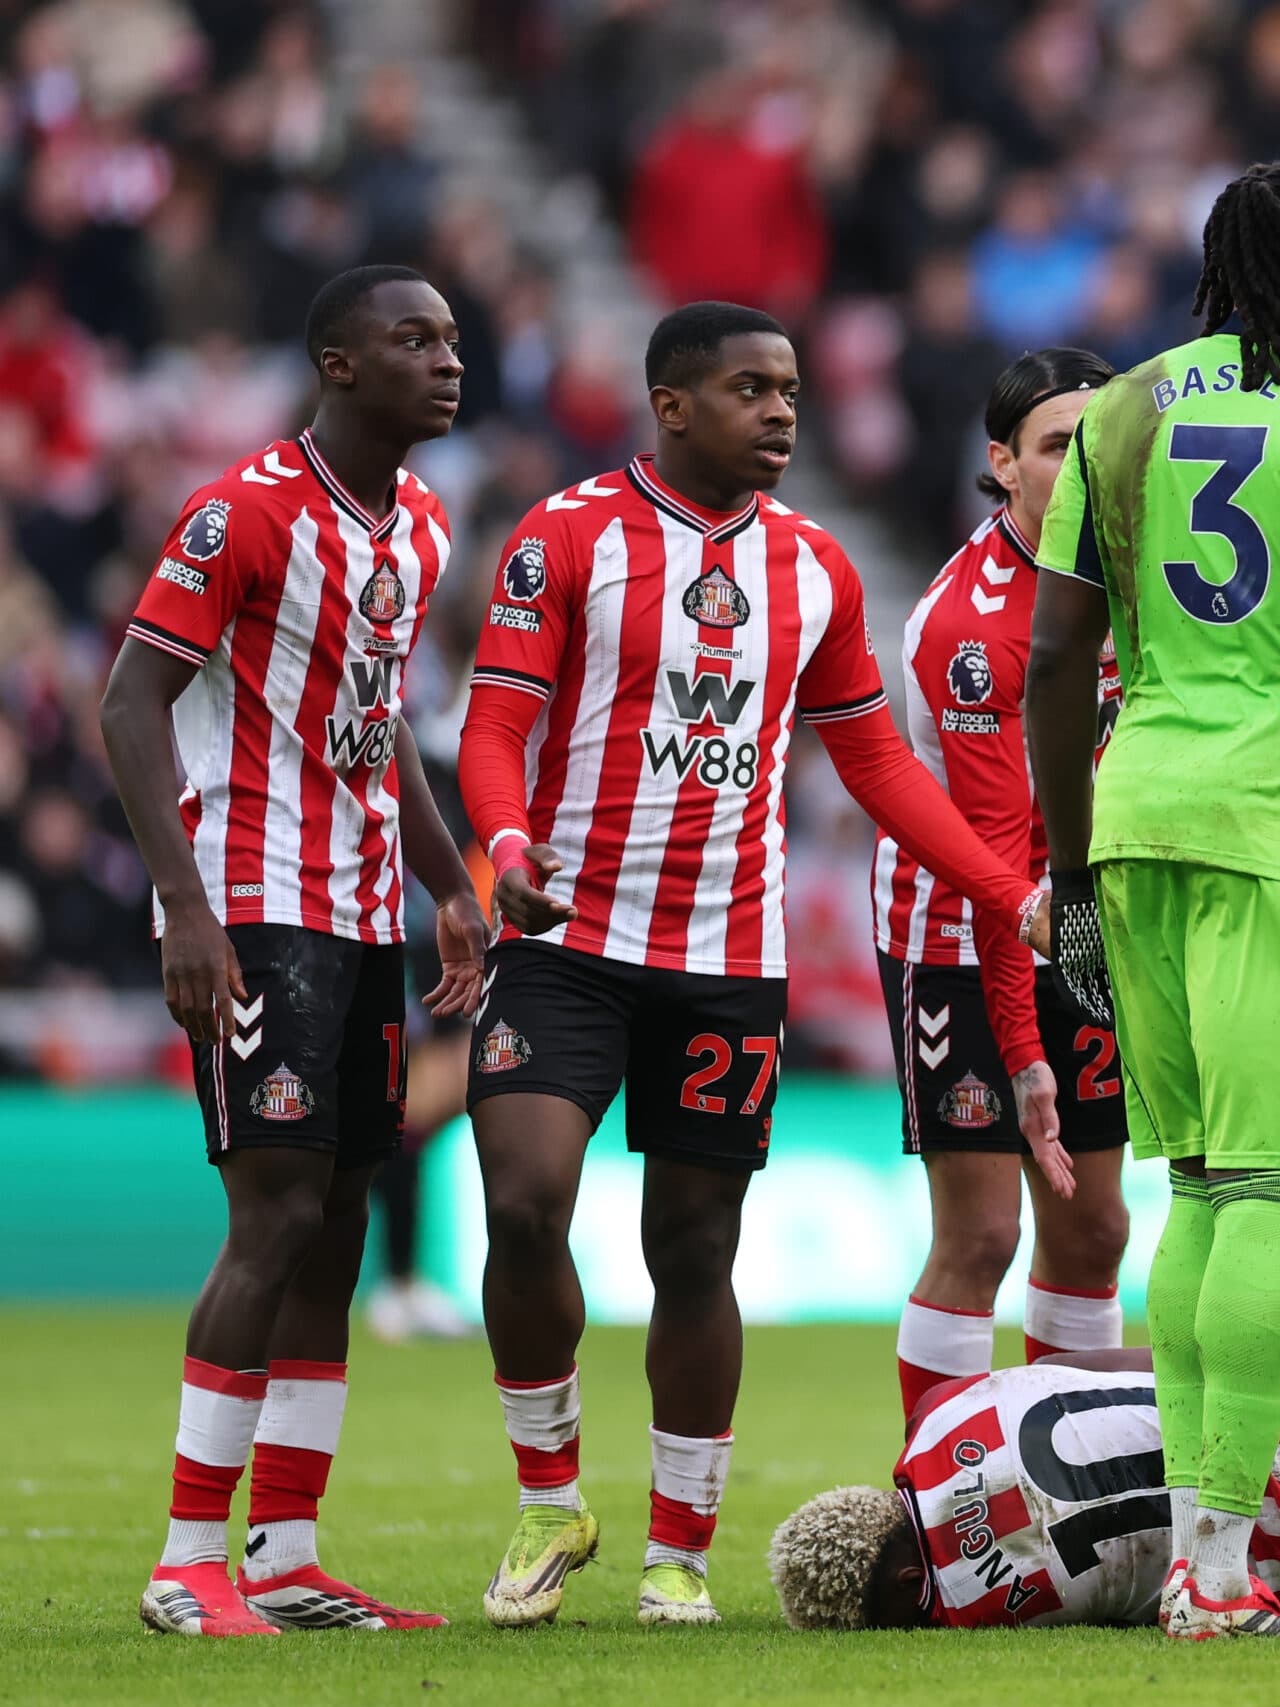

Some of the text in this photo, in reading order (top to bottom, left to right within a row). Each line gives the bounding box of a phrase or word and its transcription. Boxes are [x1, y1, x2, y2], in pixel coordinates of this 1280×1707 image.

[1162, 424, 1271, 625] 3
[168, 571, 205, 595] racism
[174, 562, 205, 583] room
[501, 617, 540, 633] racism
[505, 607, 536, 622] room
[702, 644, 742, 659] hummel
[941, 721, 1000, 734] for racism
[942, 708, 994, 724] No room
[326, 715, 399, 768] W88
[642, 730, 757, 788] W88
[232, 885, 262, 896] ECO8
[679, 1033, 777, 1115] 27
[1073, 1024, 1120, 1100] 2
[1018, 1386, 1173, 1579] 10
[951, 1438, 1040, 1613] ANGULO
